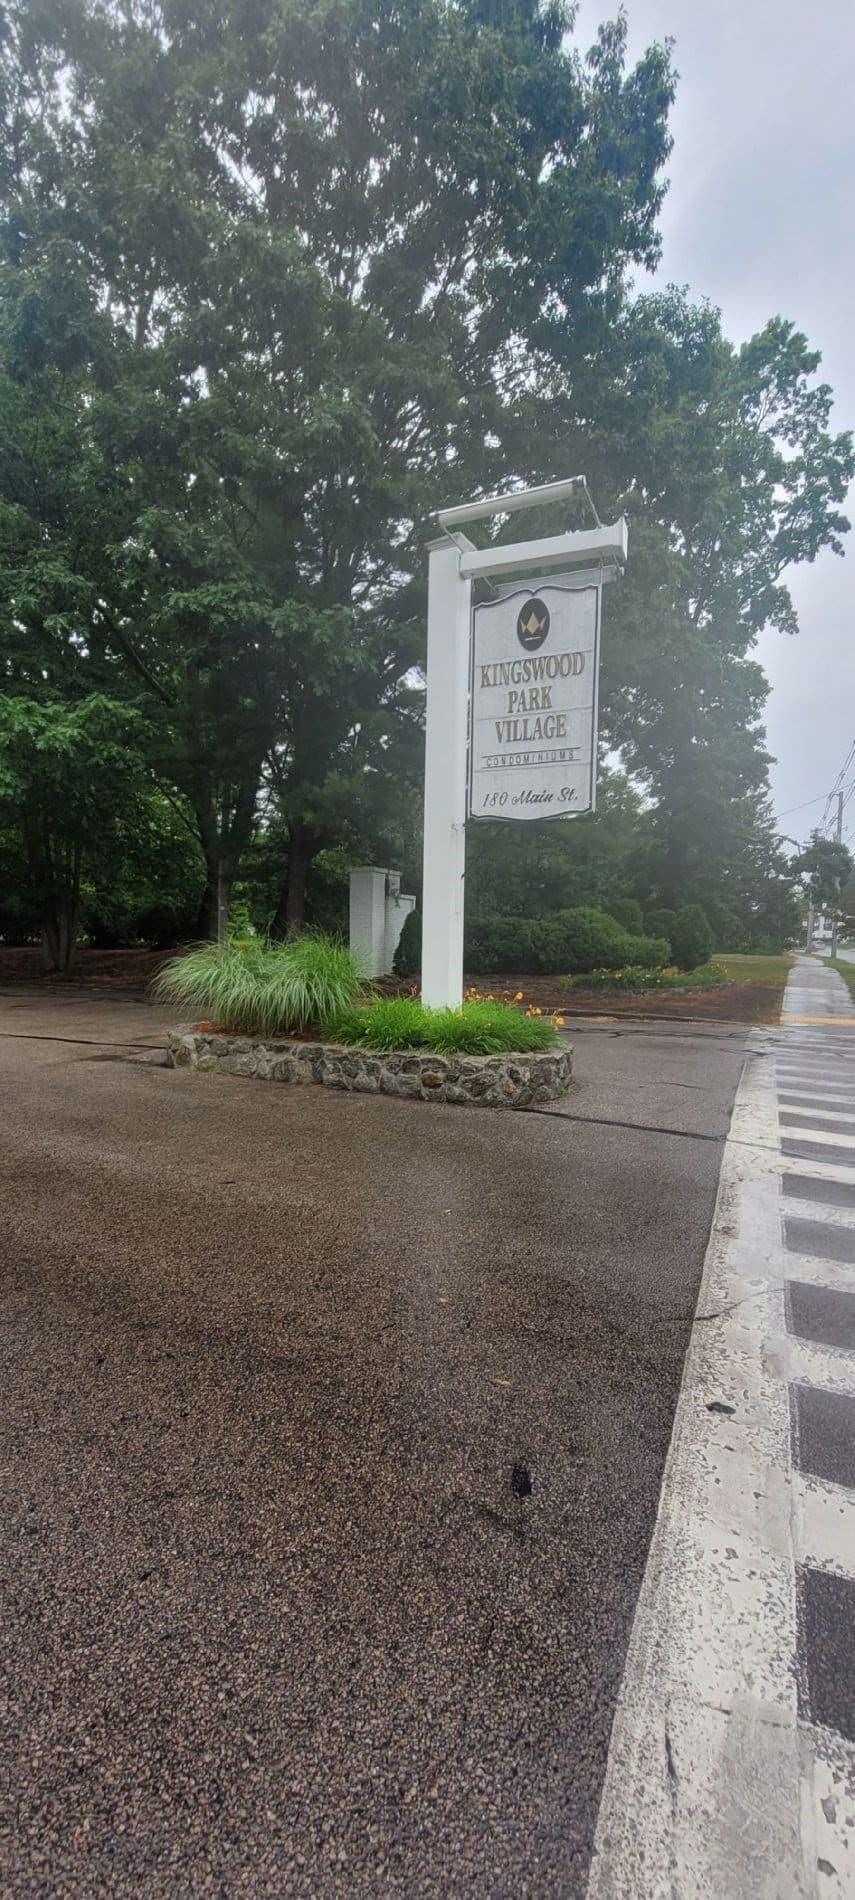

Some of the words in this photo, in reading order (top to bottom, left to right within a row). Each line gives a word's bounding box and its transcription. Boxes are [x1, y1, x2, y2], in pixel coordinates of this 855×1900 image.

[480, 651, 585, 688] KINGSWOOD
[507, 686, 553, 714] PARK
[495, 714, 567, 743] VILLAGE
[486, 751, 575, 767] CONDOMINIUMS
[482, 791, 507, 807] 180
[512, 789, 553, 805] Main
[557, 787, 578, 802] St.
